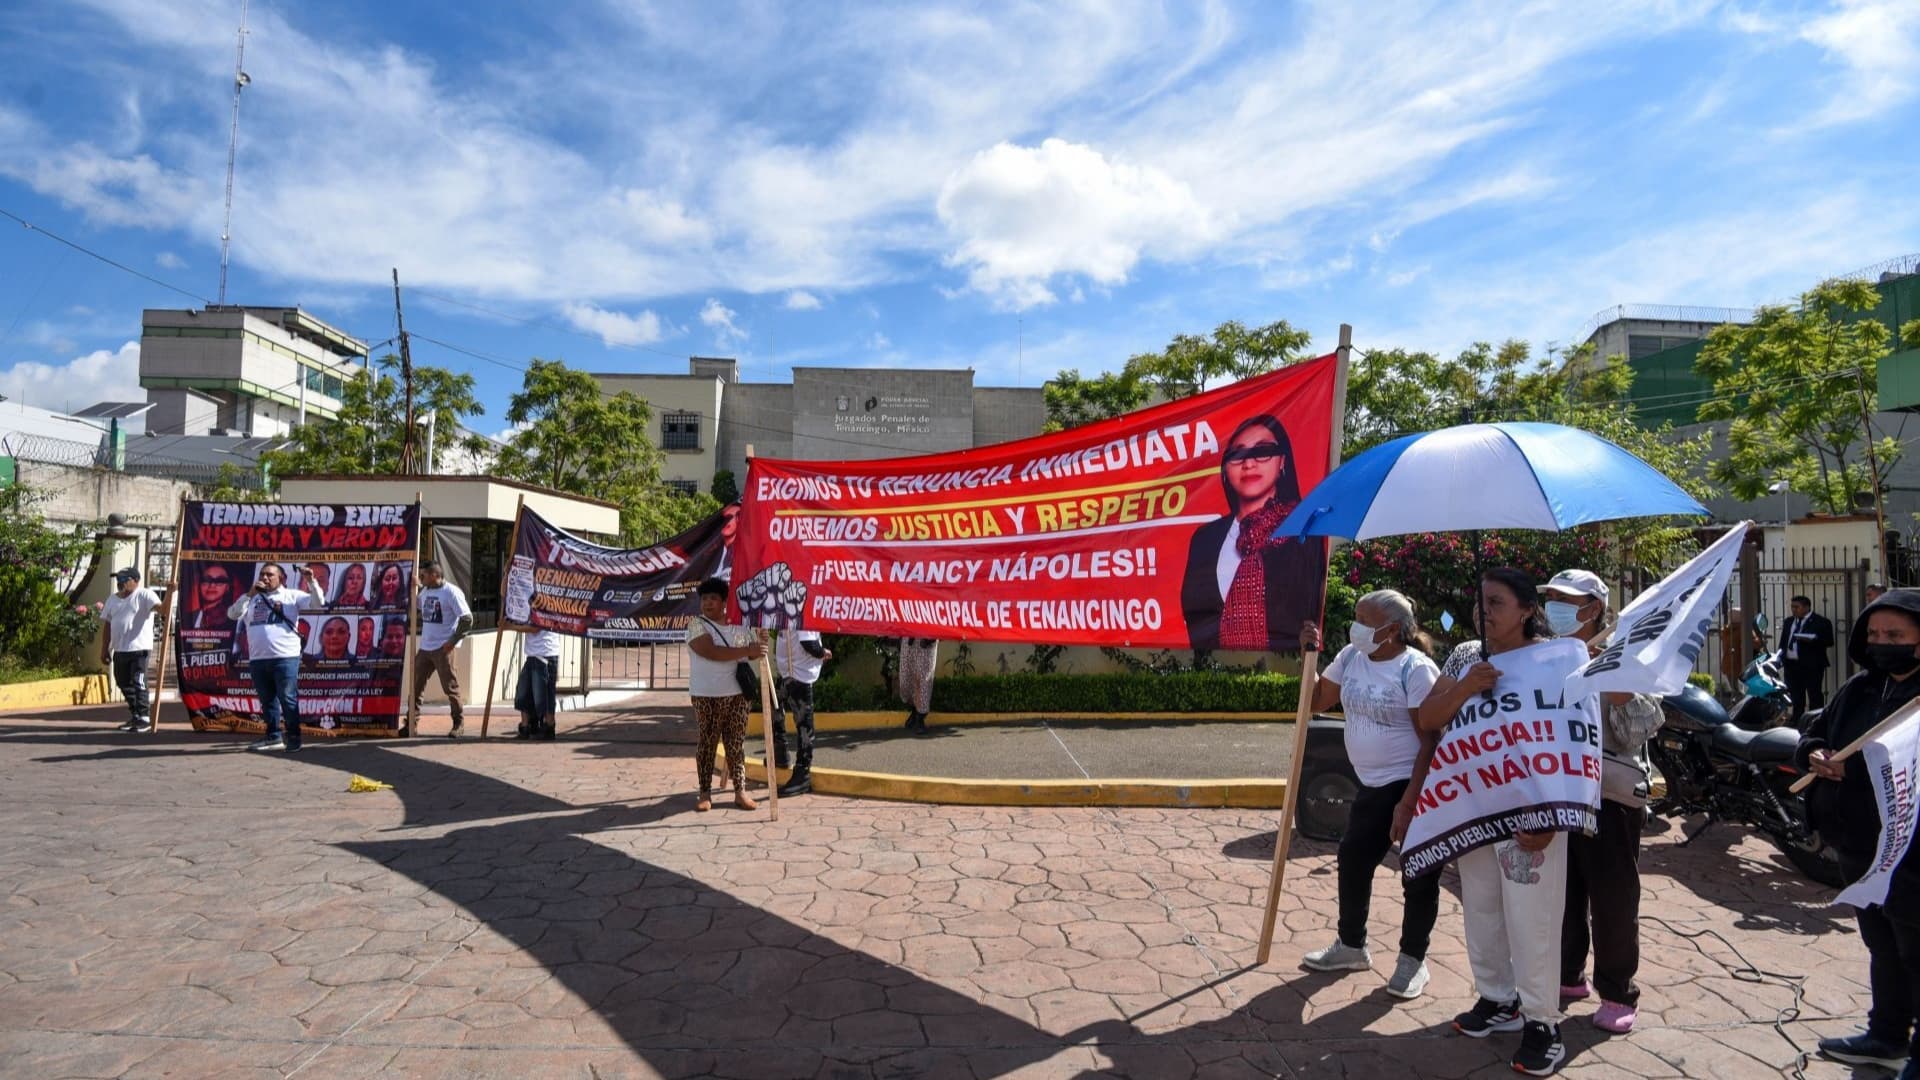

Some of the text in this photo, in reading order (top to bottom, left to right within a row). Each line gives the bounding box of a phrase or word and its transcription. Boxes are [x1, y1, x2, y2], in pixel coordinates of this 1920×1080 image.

[835, 414, 930, 425] Juzgados Penales de
[835, 423, 890, 434] Tenancingo,
[844, 475, 876, 500] TU
[877, 463, 1014, 497] RENUNCIA
[1020, 420, 1220, 483] INMEDIATA
[202, 503, 407, 527] TENANCINGO EXIGE
[769, 484, 1187, 542] QUEREMOS JUSTICIA Y RESPETO
[191, 525, 408, 549] JUSTICIA Y VERDAD
[811, 547, 1157, 585] ¡¡FUERA NANCY NÁPOLES!!
[536, 567, 602, 591] RENUNCIA
[532, 593, 590, 617] DIGNIDAD
[812, 595, 1162, 631] PRESIDENTA MUNICIPAL DE TENANCINGO
[640, 615, 671, 630] NANCY
[191, 652, 226, 667] PUEBLO
[371, 688, 384, 696] LEY
[298, 696, 354, 715] RUPCIÓN
[1429, 719, 1599, 772] UNCIA!! DE
[1413, 772, 1473, 817] NCY
[1887, 804, 1897, 819] DE
[1448, 822, 1497, 853] PUEBLO
[1493, 819, 1506, 836] Y
[1503, 809, 1556, 832] EXIGIMOS
